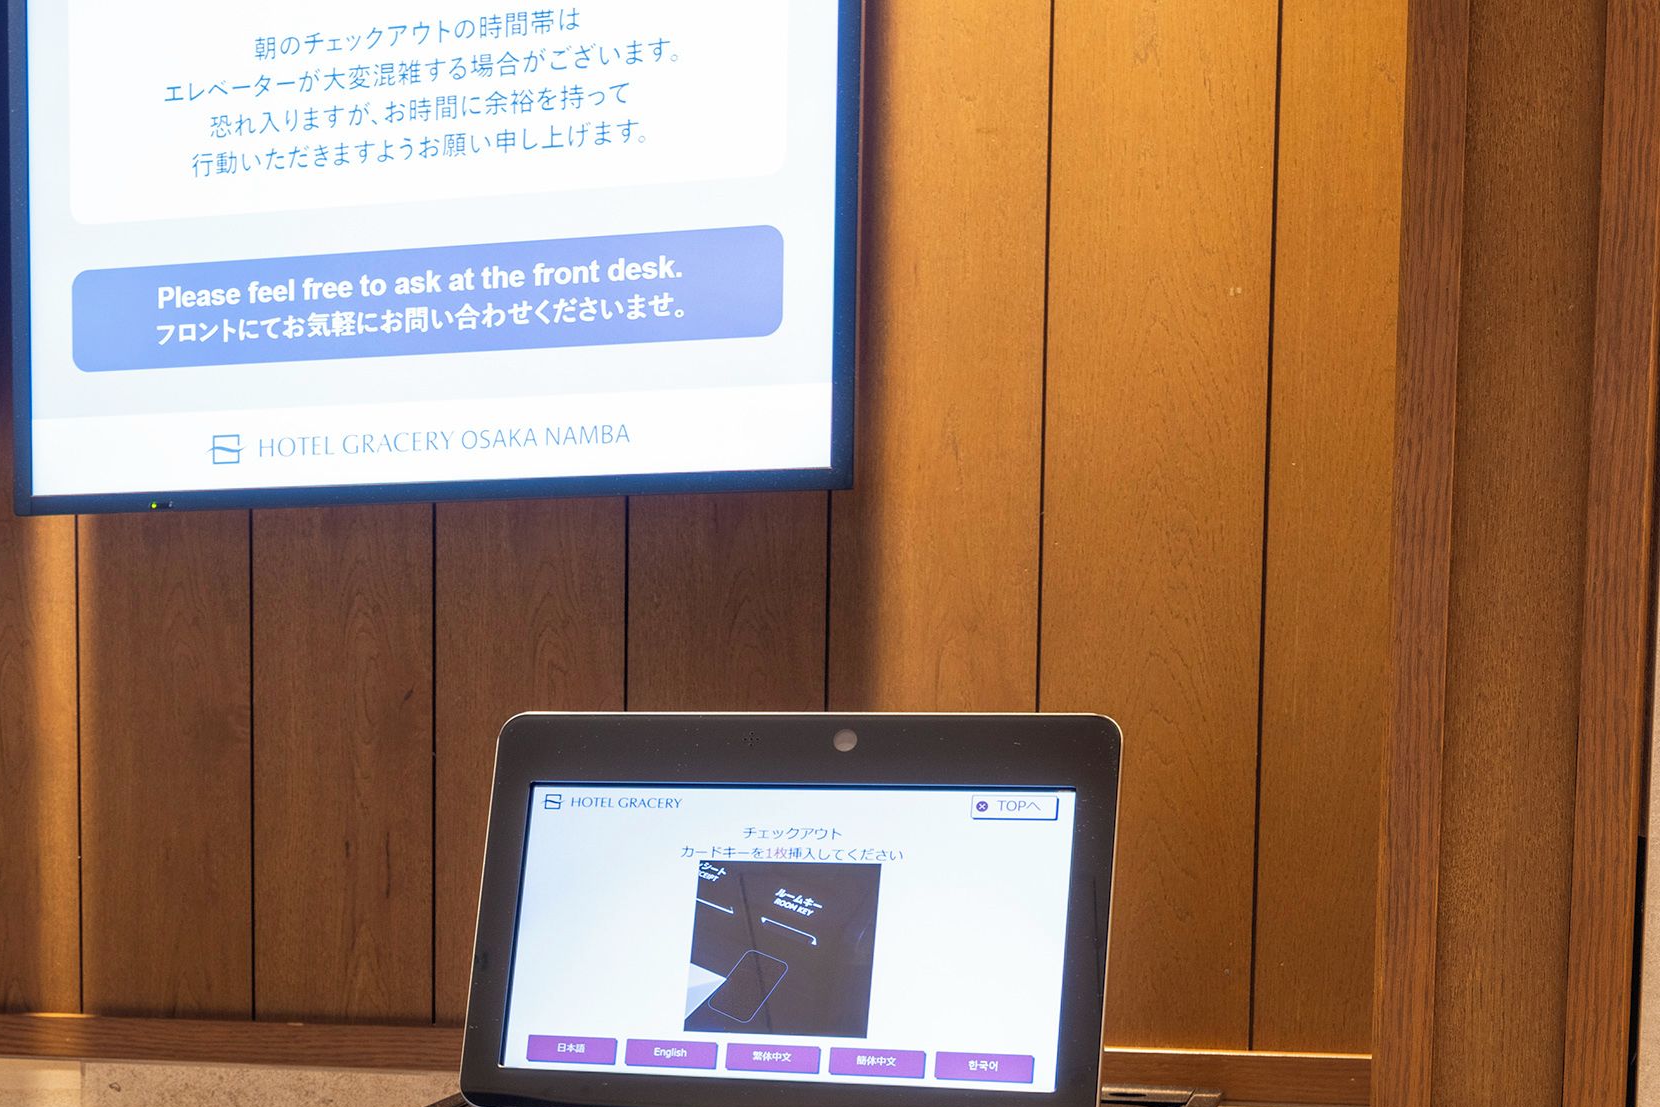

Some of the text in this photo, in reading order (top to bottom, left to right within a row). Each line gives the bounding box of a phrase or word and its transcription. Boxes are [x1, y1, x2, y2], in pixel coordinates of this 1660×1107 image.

[255, 8, 580, 60] 朝のチェックアウトの時間帯は
[165, 38, 678, 102] エレベーターが大変混雑する場合がございます。
[210, 82, 630, 139] 恐れ入りますが、お時間に余裕を持って
[192, 119, 646, 177] 行動いただきますようお願い申し上げます。
[157, 255, 682, 309] Please feel free to ask at the front desk.
[156, 292, 685, 346] フロントにてお気軽にお問い合わせくださいませ。
[259, 424, 630, 458] HOTEL GRACERY OSAKA NAMBA
[570, 797, 683, 809] HOTEL GRACERY
[742, 827, 842, 841] チェックアウト
[681, 845, 904, 863] カードキーを1枚挿入してください
[773, 897, 814, 917] ROOM KEY
[775, 887, 823, 909] ルームキー
[557, 1043, 586, 1054] 日本語
[653, 1047, 688, 1059] English
[968, 1059, 999, 1072] 한국어
